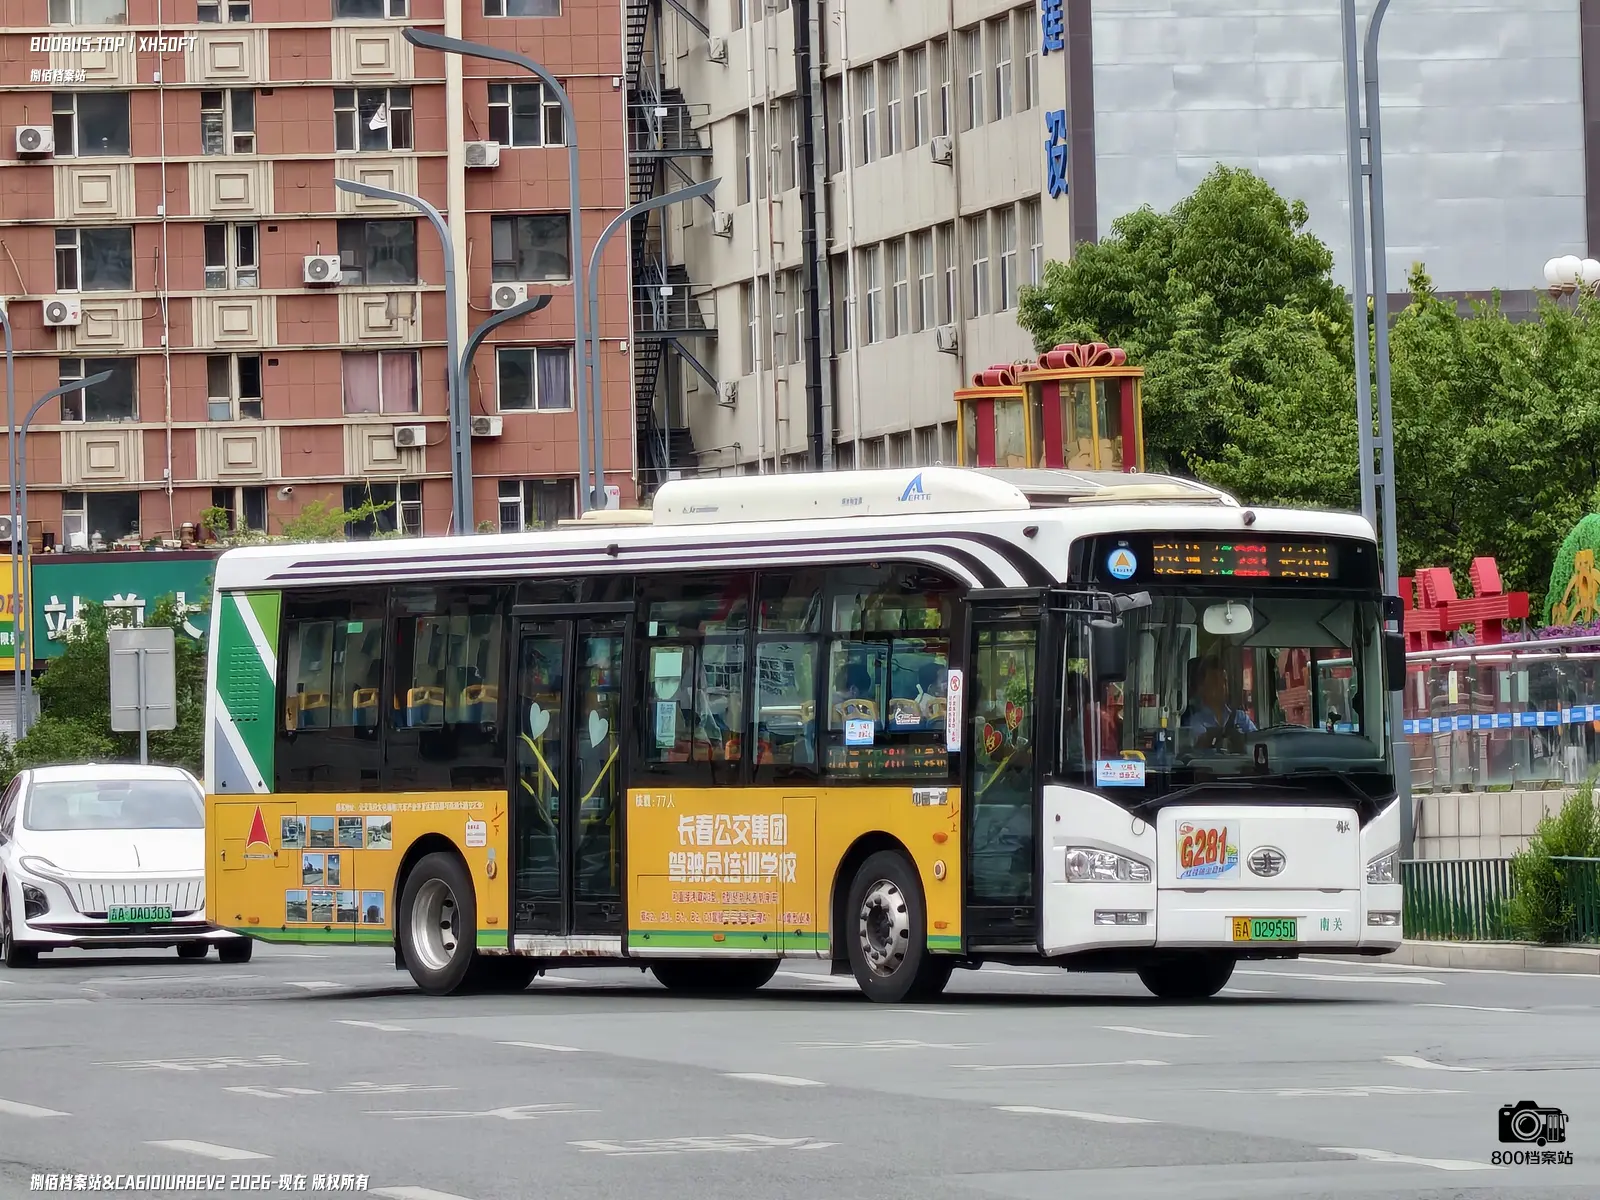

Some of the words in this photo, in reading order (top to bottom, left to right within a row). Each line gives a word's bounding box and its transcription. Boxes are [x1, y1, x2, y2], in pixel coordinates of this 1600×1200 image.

[677, 814, 788, 846] 长春公交集团
[1181, 826, 1228, 869] G281
[668, 851, 798, 883] 驾驶员培训学校
[1320, 917, 1342, 931] 南关
